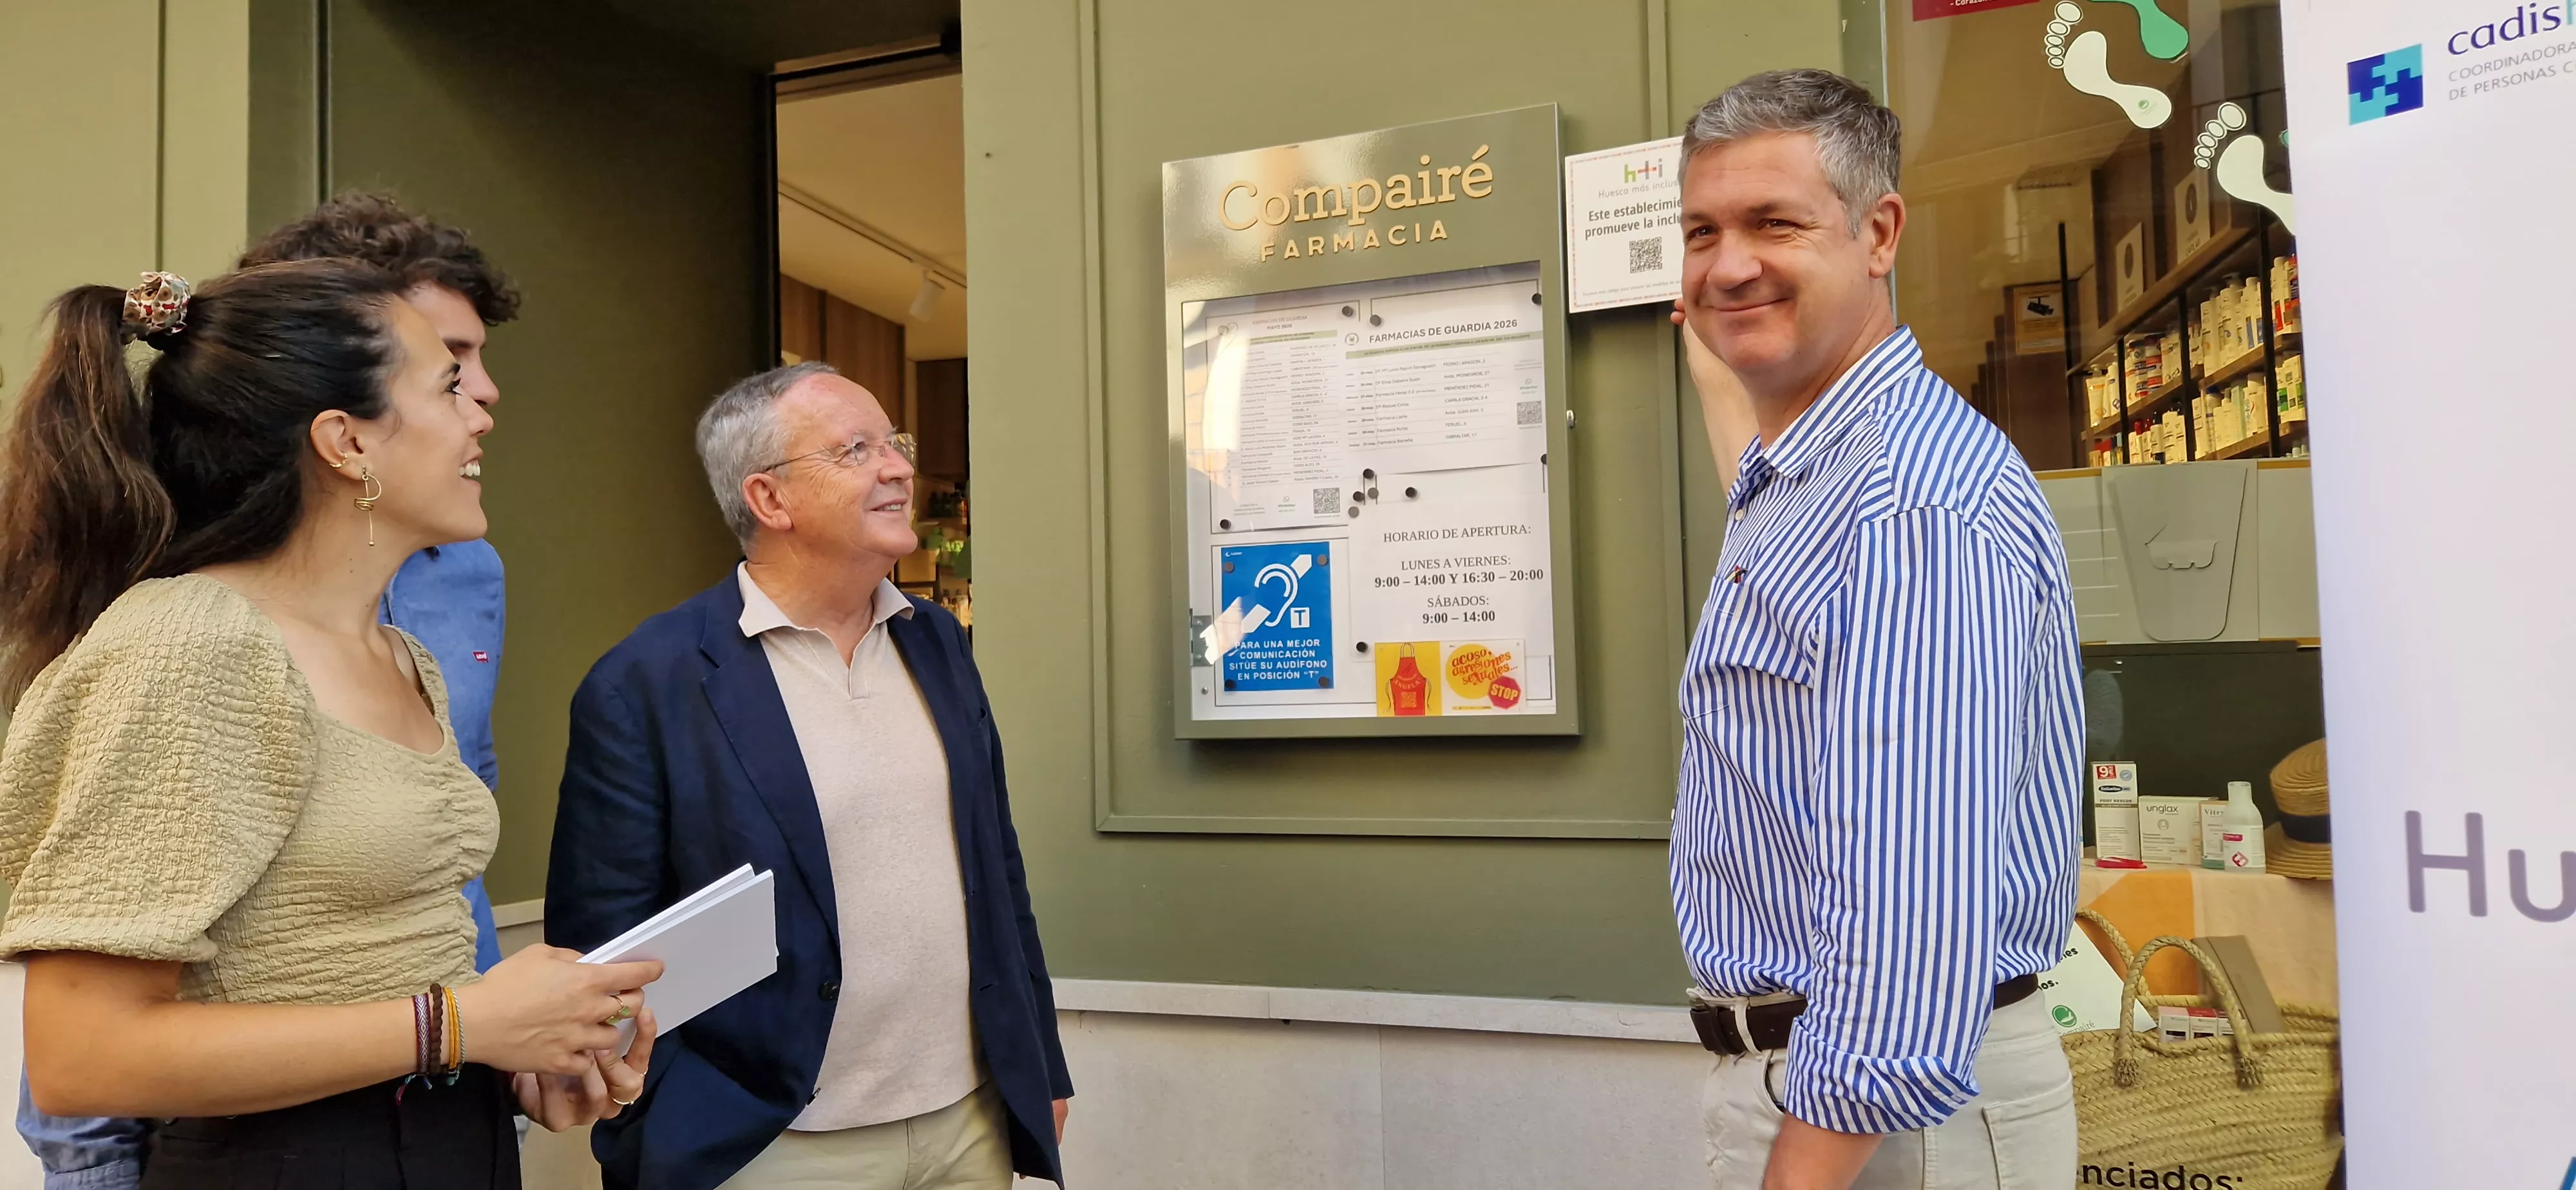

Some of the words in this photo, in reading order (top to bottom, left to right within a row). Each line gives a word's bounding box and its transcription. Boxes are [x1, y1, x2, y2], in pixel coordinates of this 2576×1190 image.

[2448, 41, 2576, 82] COORDINADORA
[2449, 88, 2467, 100] DE
[2475, 65, 2556, 95] PERSONAS
[2563, 61, 2576, 73] C
[1218, 144, 1493, 231] Compairé
[1598, 188, 1628, 198] Huesca
[1632, 184, 1649, 193] más
[1589, 210, 1610, 222] Este
[1614, 196, 1682, 218] establecimie
[1585, 220, 1640, 241] promueve
[1643, 217, 1653, 229] la
[1260, 220, 1448, 262] FARMACIA
[1369, 329, 1425, 343] FARMACIAS
[1428, 326, 1441, 336] DE
[1444, 323, 1491, 334] GUARDIA
[1494, 319, 1517, 330] 2026
[1384, 529, 1439, 543] HORARIO
[1443, 529, 1458, 539] DE
[1461, 524, 1531, 538] APERTURA:
[1401, 559, 1440, 571] LUNES
[1443, 558, 1452, 568] A
[1454, 555, 1511, 567] VIERNES:
[1375, 576, 1399, 588] 9:00
[1414, 574, 1446, 586] 14:00
[1449, 573, 1458, 584] Y
[1463, 571, 1495, 583] 16:30
[1510, 569, 1544, 581] 20:00
[1427, 596, 1490, 608] SÁBADOS:
[1294, 609, 1306, 625] T
[1423, 612, 1448, 624] 9:00
[1463, 610, 1495, 623] 14:00
[1264, 640, 1283, 648] UNA
[1287, 639, 1320, 647] MEJOR
[1240, 648, 1315, 659] COMUNICACIÓN
[1452, 649, 1492, 668] acoso,
[1229, 660, 1256, 670] SITÚE
[1260, 661, 1273, 670] SU
[1276, 659, 1327, 669] AUDÍFONO
[1452, 652, 1511, 676] agresiones
[1253, 670, 1300, 679] POSICIÓN
[1490, 683, 1519, 701] STOP
[2146, 804, 2179, 815] unglax
[2405, 810, 2576, 923] Hu
[2058, 1020, 2096, 1036] omairé
[2077, 1161, 2243, 1190] nciados:
